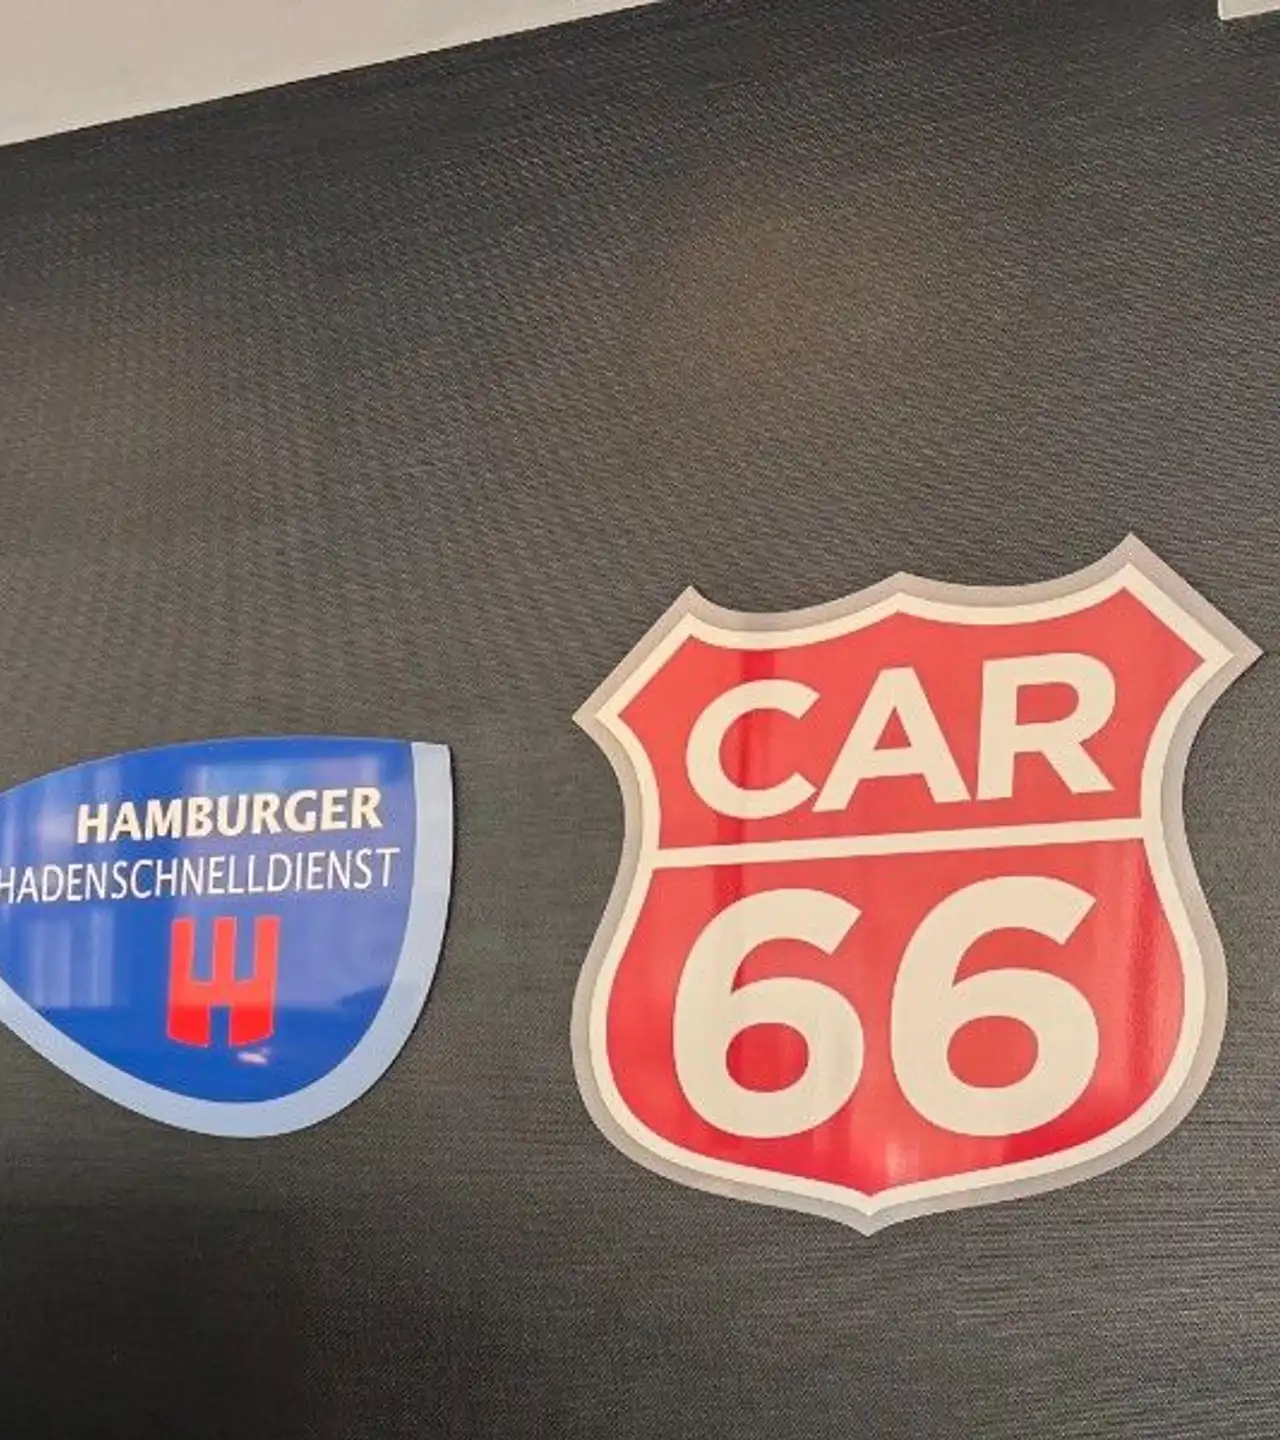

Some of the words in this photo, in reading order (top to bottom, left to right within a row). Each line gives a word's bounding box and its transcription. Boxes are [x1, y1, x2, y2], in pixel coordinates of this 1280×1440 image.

[77, 787, 382, 844] HAMBURGER
[685, 652, 1116, 819] CAR
[673, 875, 1099, 1139] 66
